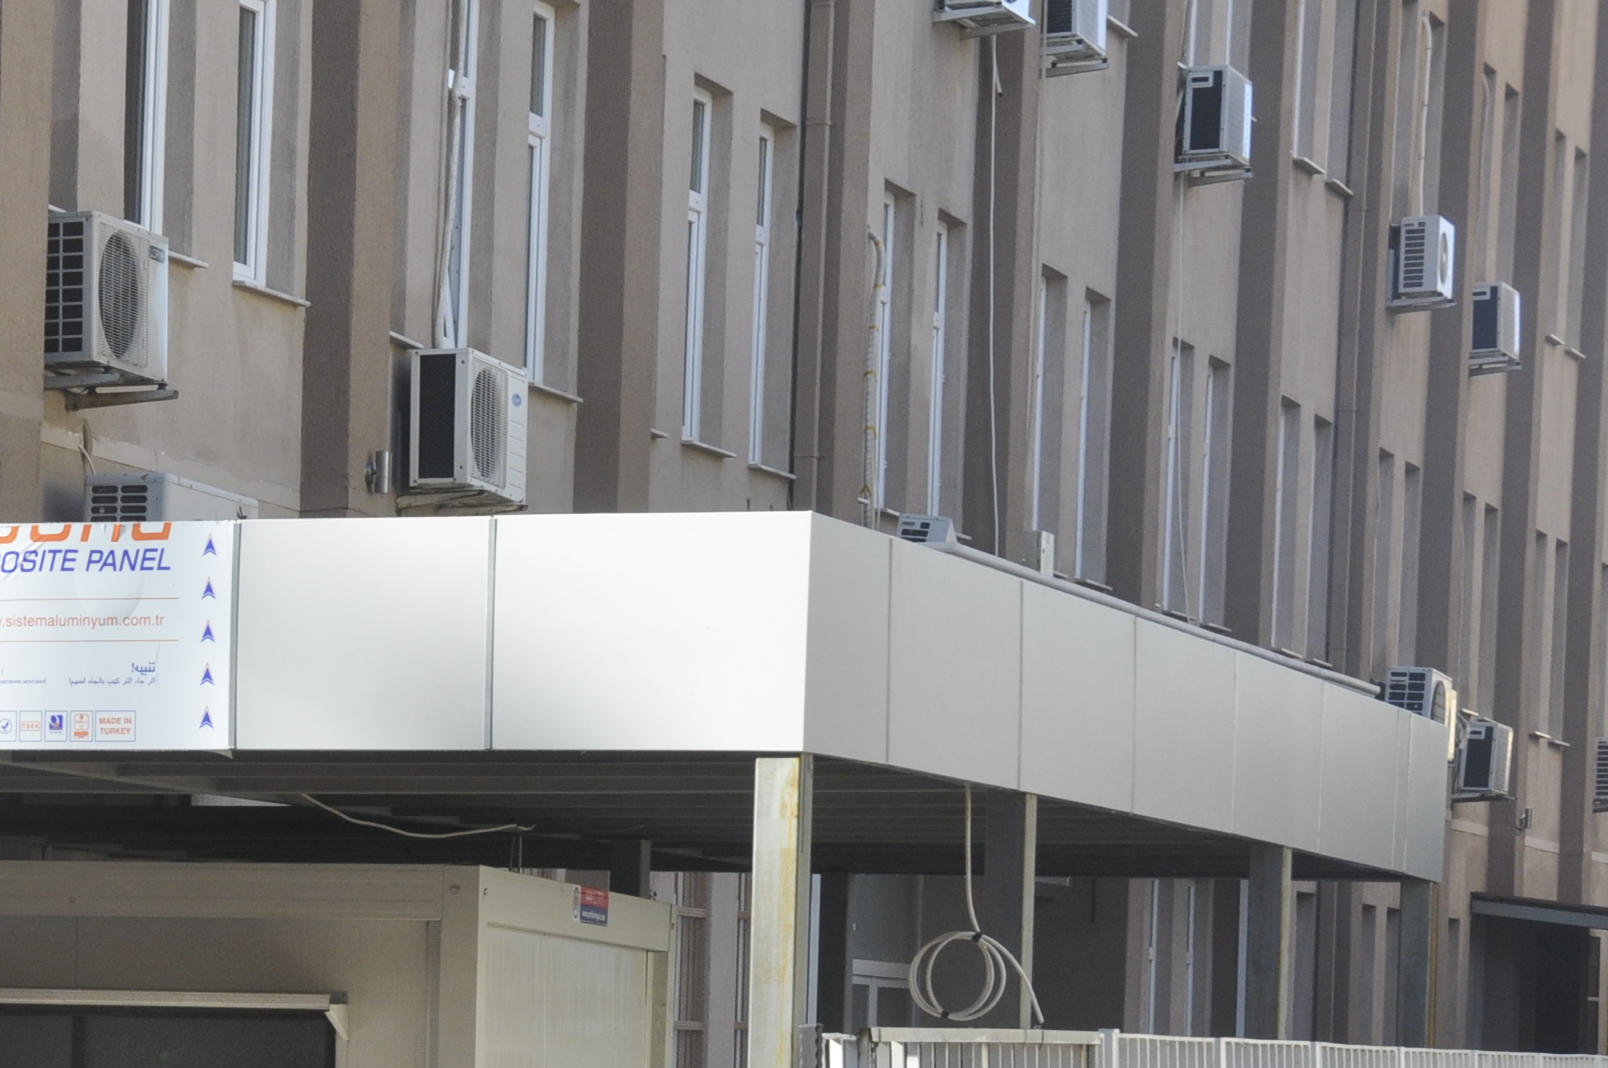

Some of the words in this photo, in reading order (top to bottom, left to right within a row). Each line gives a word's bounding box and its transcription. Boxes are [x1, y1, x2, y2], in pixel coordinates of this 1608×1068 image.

[85, 547, 171, 572] PANEL
[99, 717, 121, 725] MADE
[123, 717, 132, 725] IN
[99, 727, 131, 736] TURKEY
